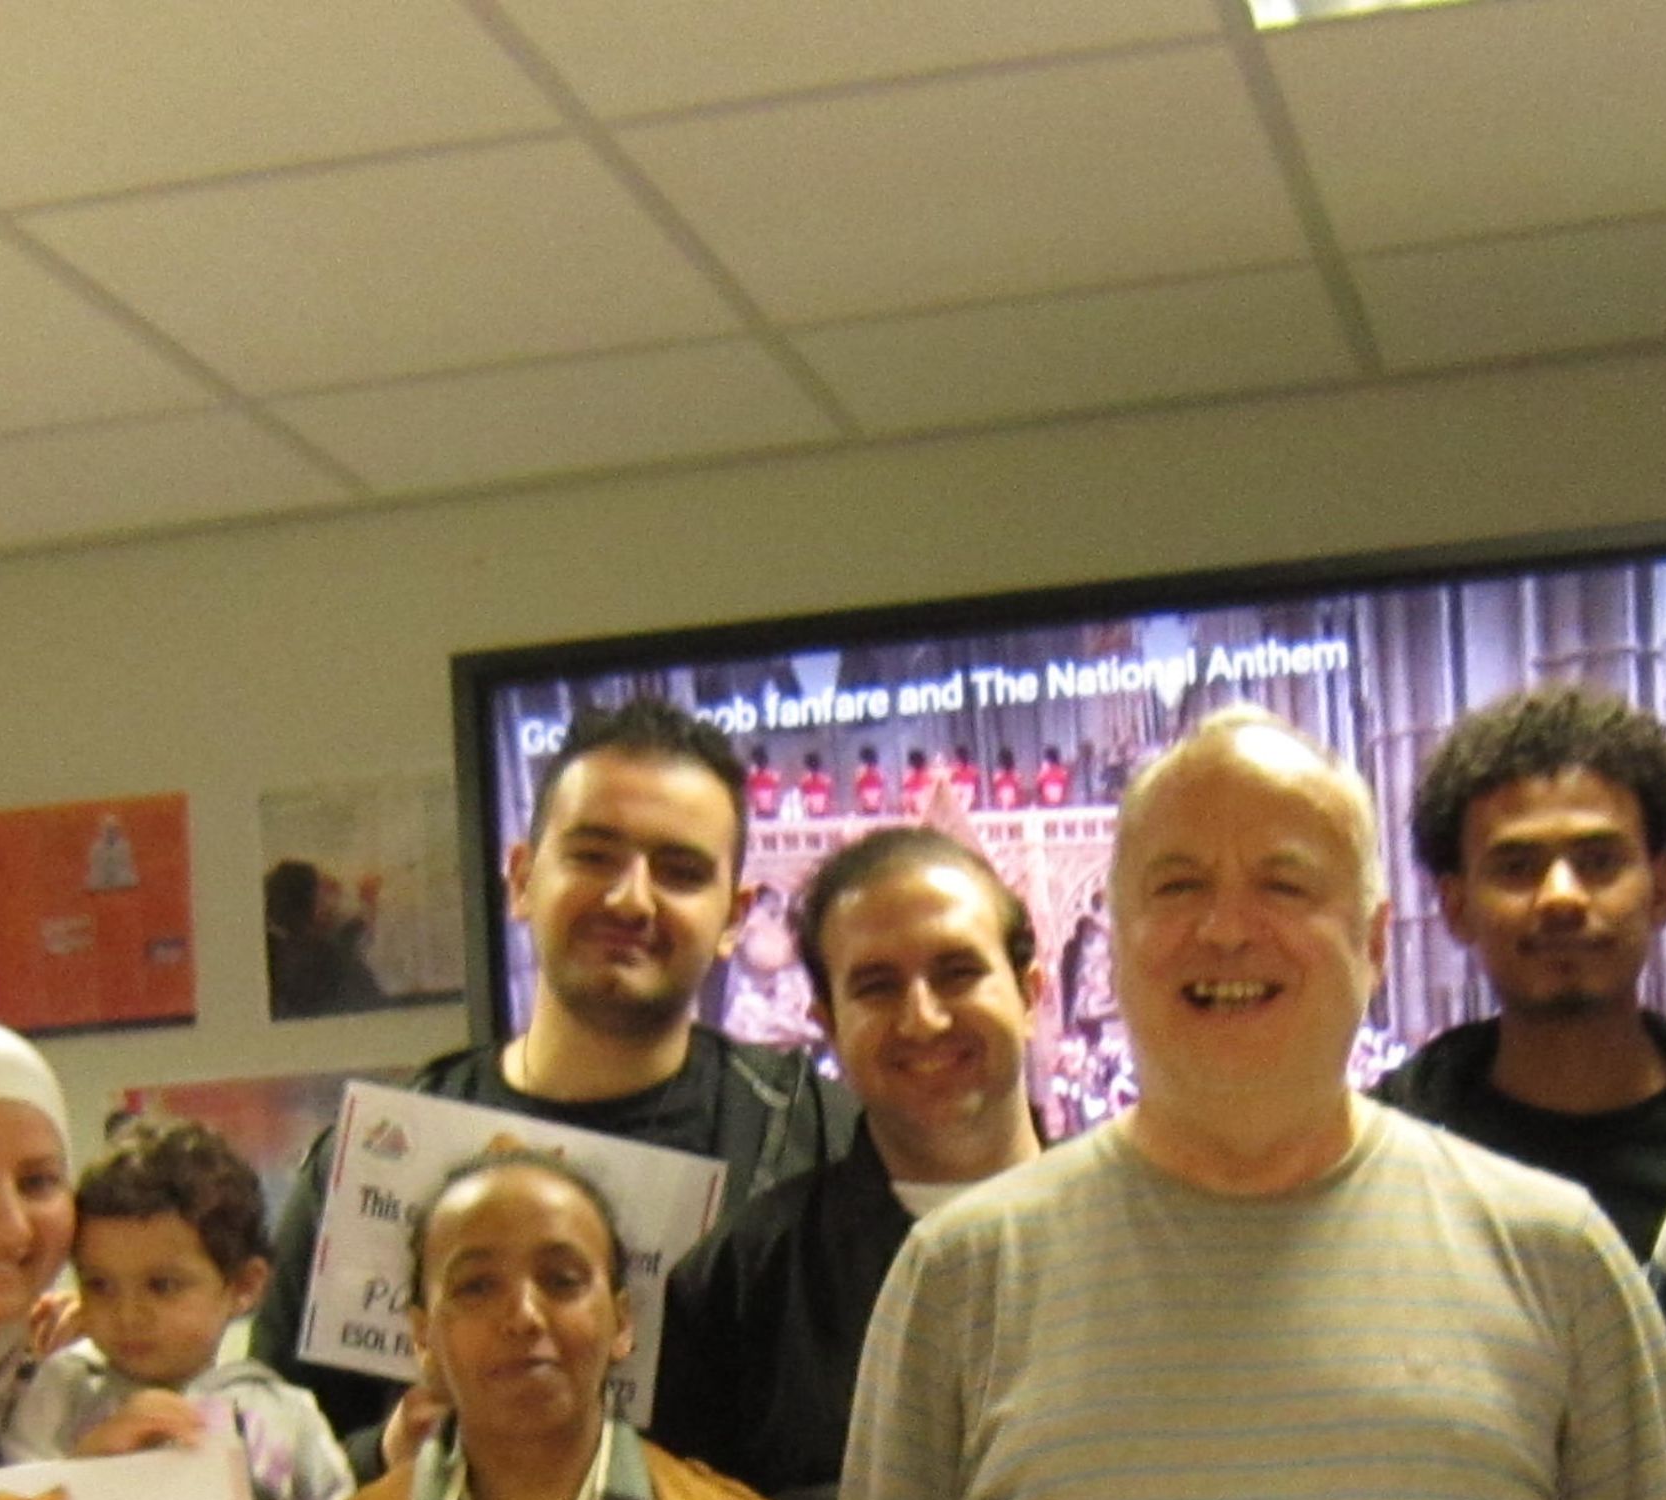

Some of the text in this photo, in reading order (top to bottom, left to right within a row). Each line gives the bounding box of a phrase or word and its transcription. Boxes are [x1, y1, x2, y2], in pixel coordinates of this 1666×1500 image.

[765, 685, 888, 729] fanfare
[897, 670, 963, 716] and
[970, 667, 1038, 708] The
[1046, 646, 1197, 699] National
[1205, 636, 1349, 684] Anthem
[360, 1184, 401, 1223] This
[340, 1320, 387, 1354] ESOL
